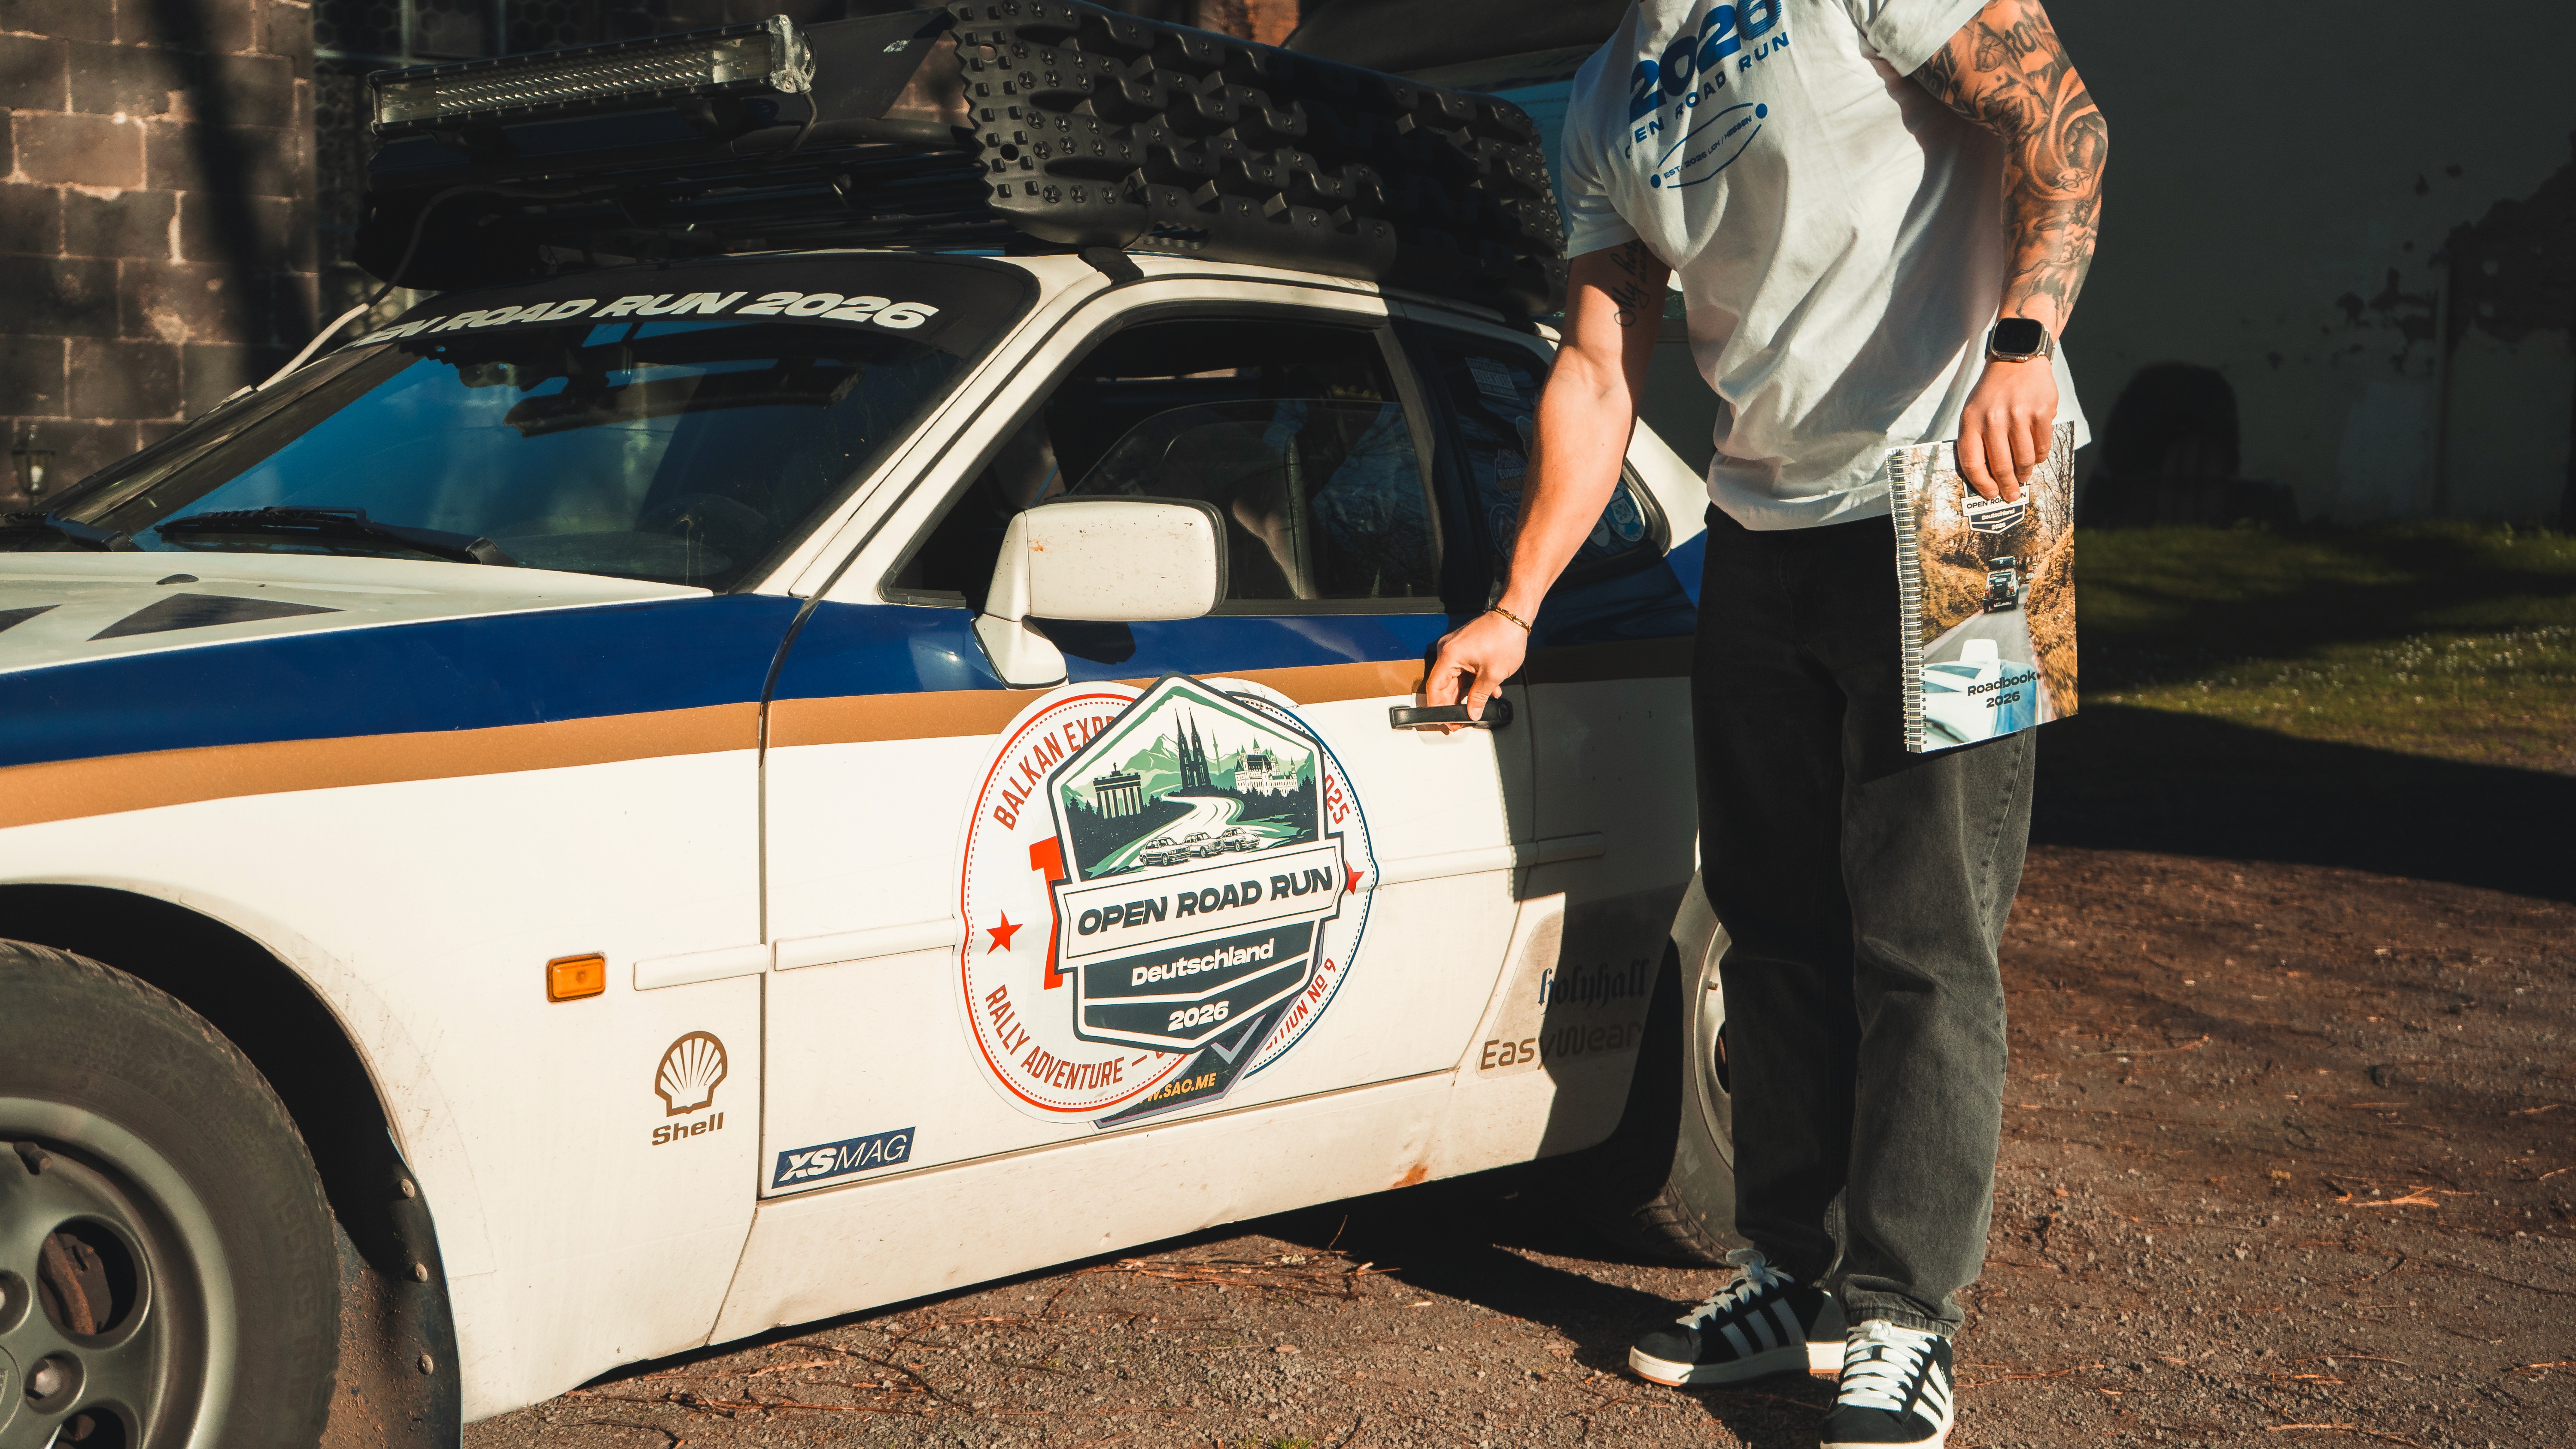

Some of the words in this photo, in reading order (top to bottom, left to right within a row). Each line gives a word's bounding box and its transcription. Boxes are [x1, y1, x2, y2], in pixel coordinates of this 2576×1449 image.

[1629, 0, 1782, 123] 2026
[1675, 71, 1726, 119] ROAD
[1738, 32, 1789, 72] RUN
[1664, 166, 1683, 179] EST.
[1684, 152, 1707, 167] 2026
[343, 316, 447, 350] EN
[428, 298, 597, 333] ROAD
[593, 292, 747, 318] RUN
[736, 291, 939, 329] 2026
[1967, 500, 1988, 509] OPEN
[1990, 497, 2005, 505] ROA
[1981, 508, 2015, 520] Deutschland
[1967, 670, 2036, 696] Roadbook
[1986, 691, 2021, 709] 2026
[993, 732, 1064, 830] BALKAN
[1325, 774, 1350, 825] 025
[1078, 895, 1167, 936] OPEN
[1177, 880, 1264, 917] ROAD
[1270, 866, 1333, 901] RUN
[1131, 939, 1274, 987] Deutschland
[1324, 958, 1336, 973] 9
[985, 984, 1031, 1056] RALLY
[1021, 1046, 1125, 1090] ADVENTURE
[1167, 1000, 1230, 1032] 2026
[1480, 1021, 1643, 1070] EasyWear
[1139, 1072, 1217, 1104] W.SAC.ME
[651, 1112, 724, 1146] Shell
[778, 1134, 907, 1182] XSMAG
